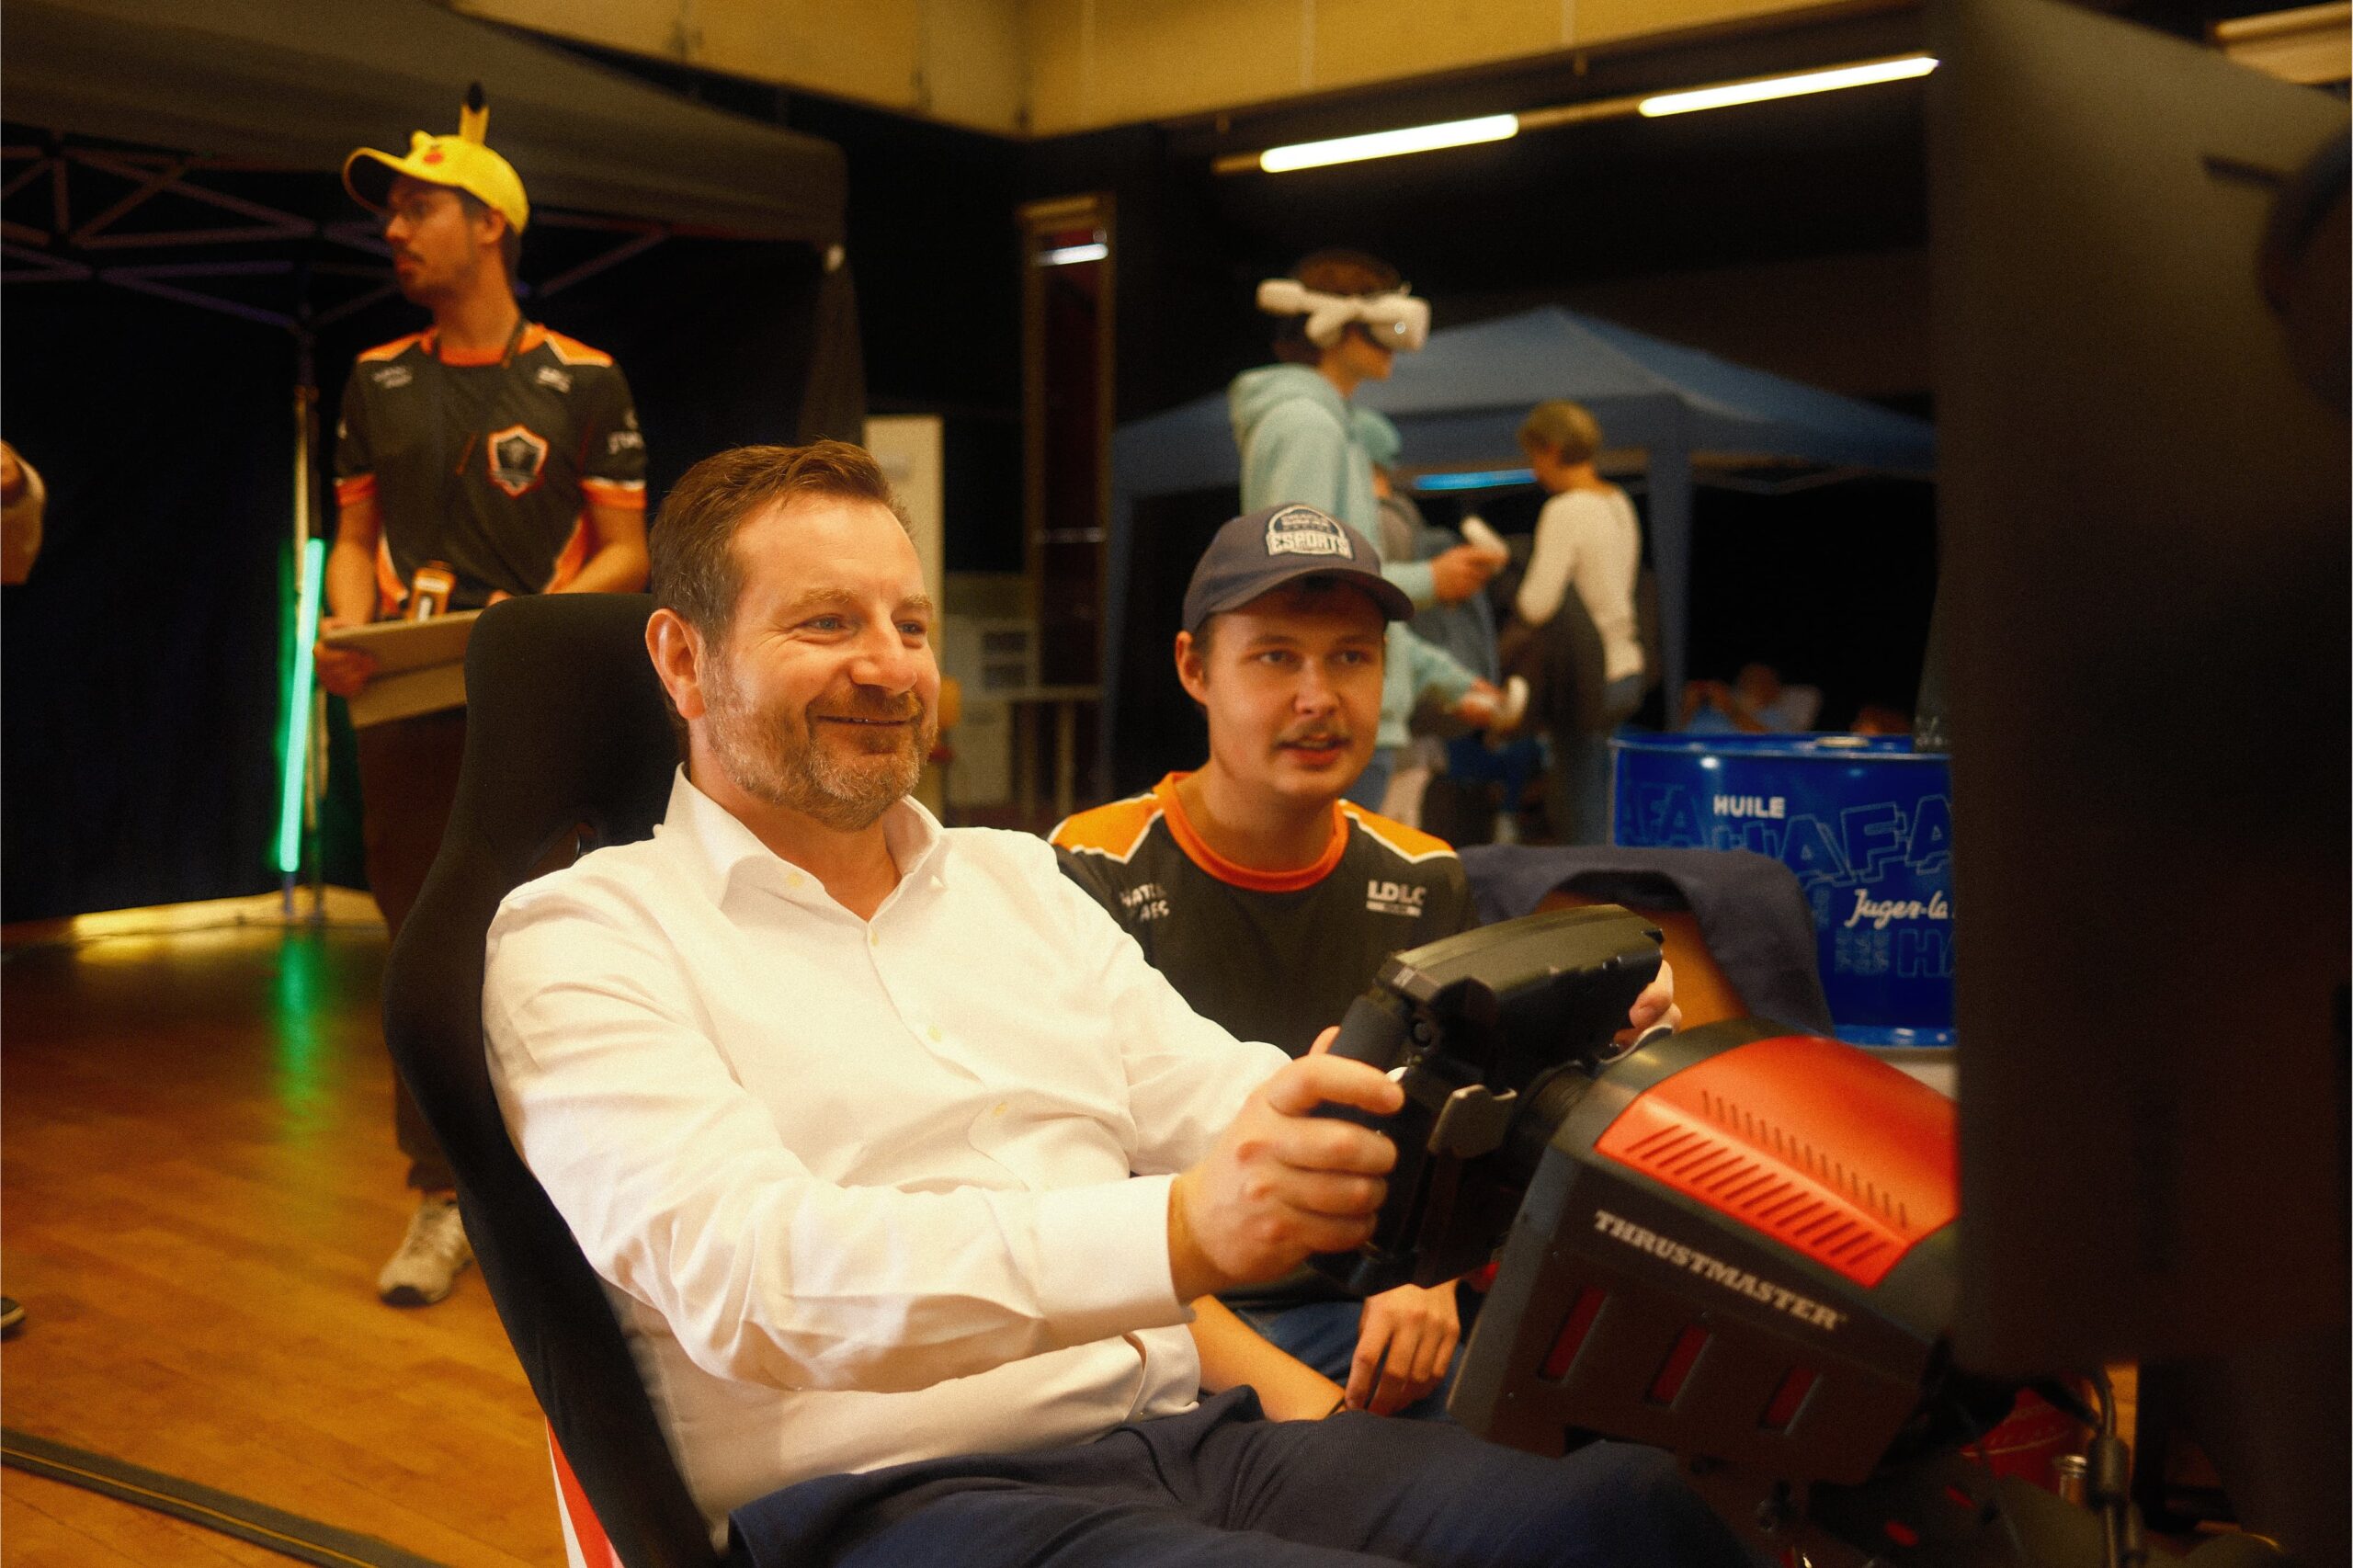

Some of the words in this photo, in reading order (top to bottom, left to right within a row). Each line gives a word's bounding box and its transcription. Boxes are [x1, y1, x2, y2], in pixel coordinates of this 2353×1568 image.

[1268, 530, 1351, 557] ESPORTS
[1713, 793, 1786, 819] HUILE
[1368, 880, 1427, 905] LDLC
[1595, 1210, 1838, 1330] THRUSTMASTER
